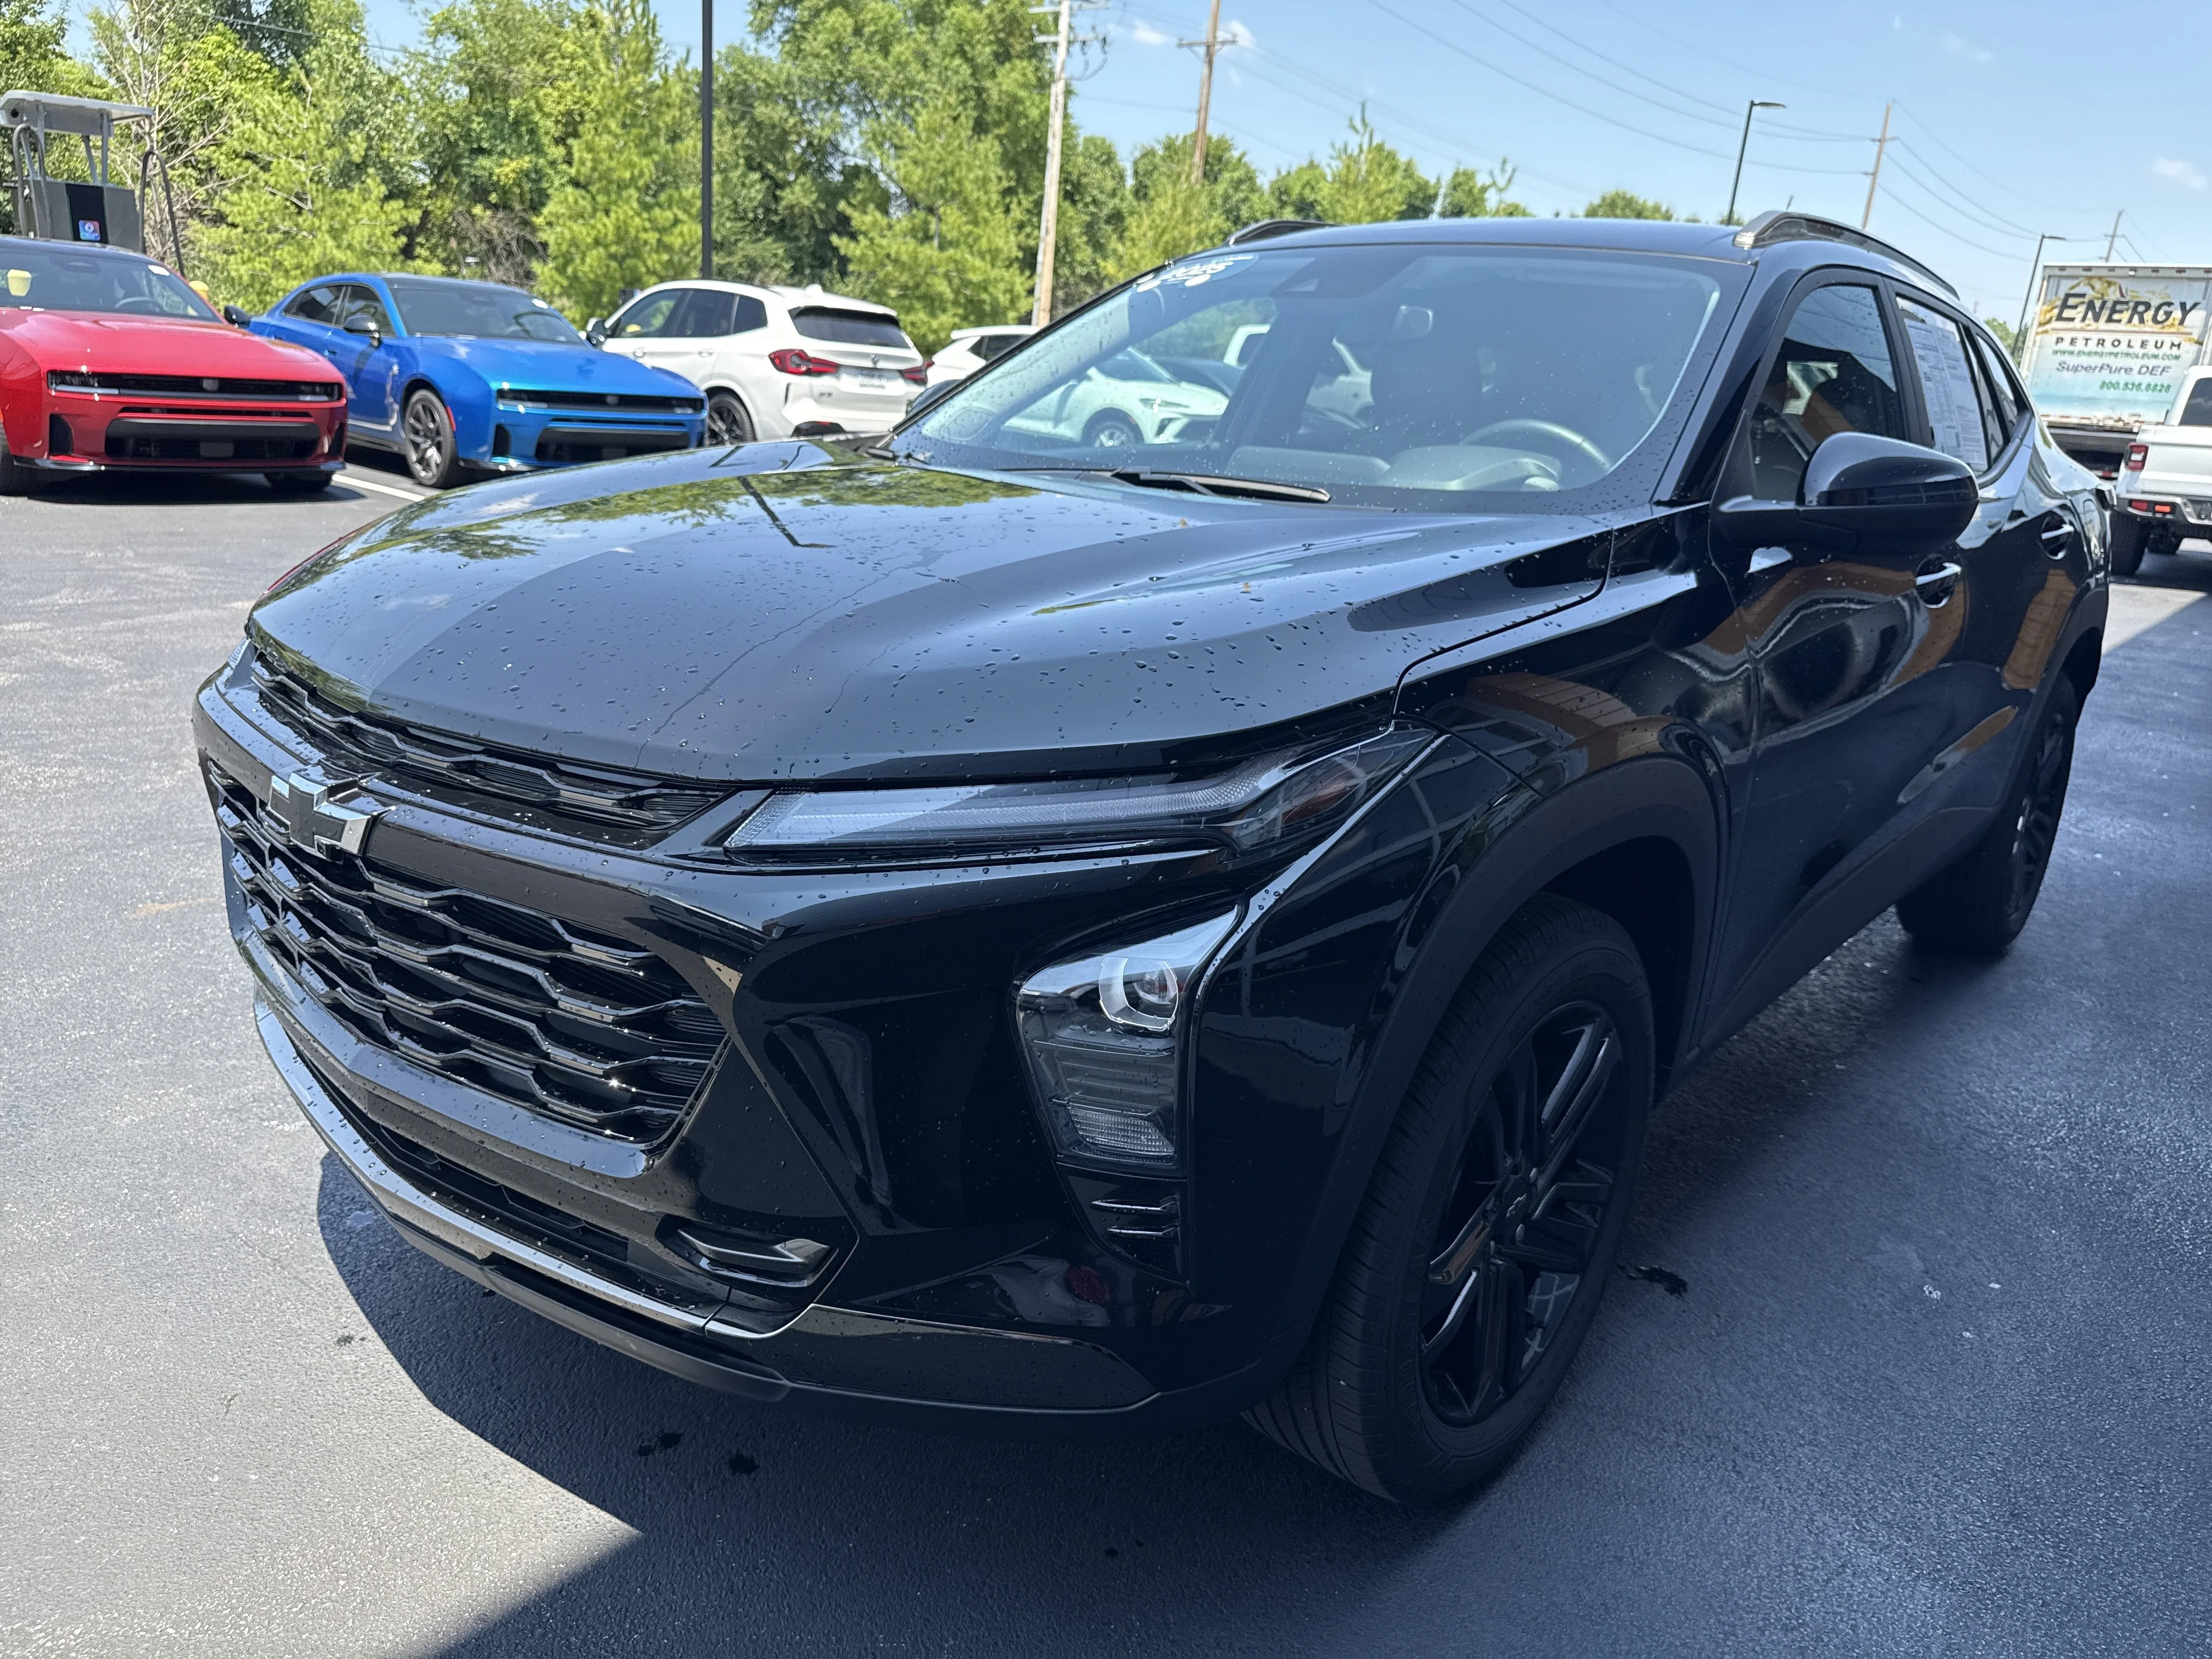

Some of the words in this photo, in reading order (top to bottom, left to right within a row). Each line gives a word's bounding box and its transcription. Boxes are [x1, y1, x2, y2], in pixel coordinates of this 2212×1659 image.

[2056, 293, 2200, 326] ENERGY
[2055, 337, 2182, 350] PETROLEUM
[2056, 362, 2134, 375] SuperPure
[2137, 364, 2171, 376] DEF
